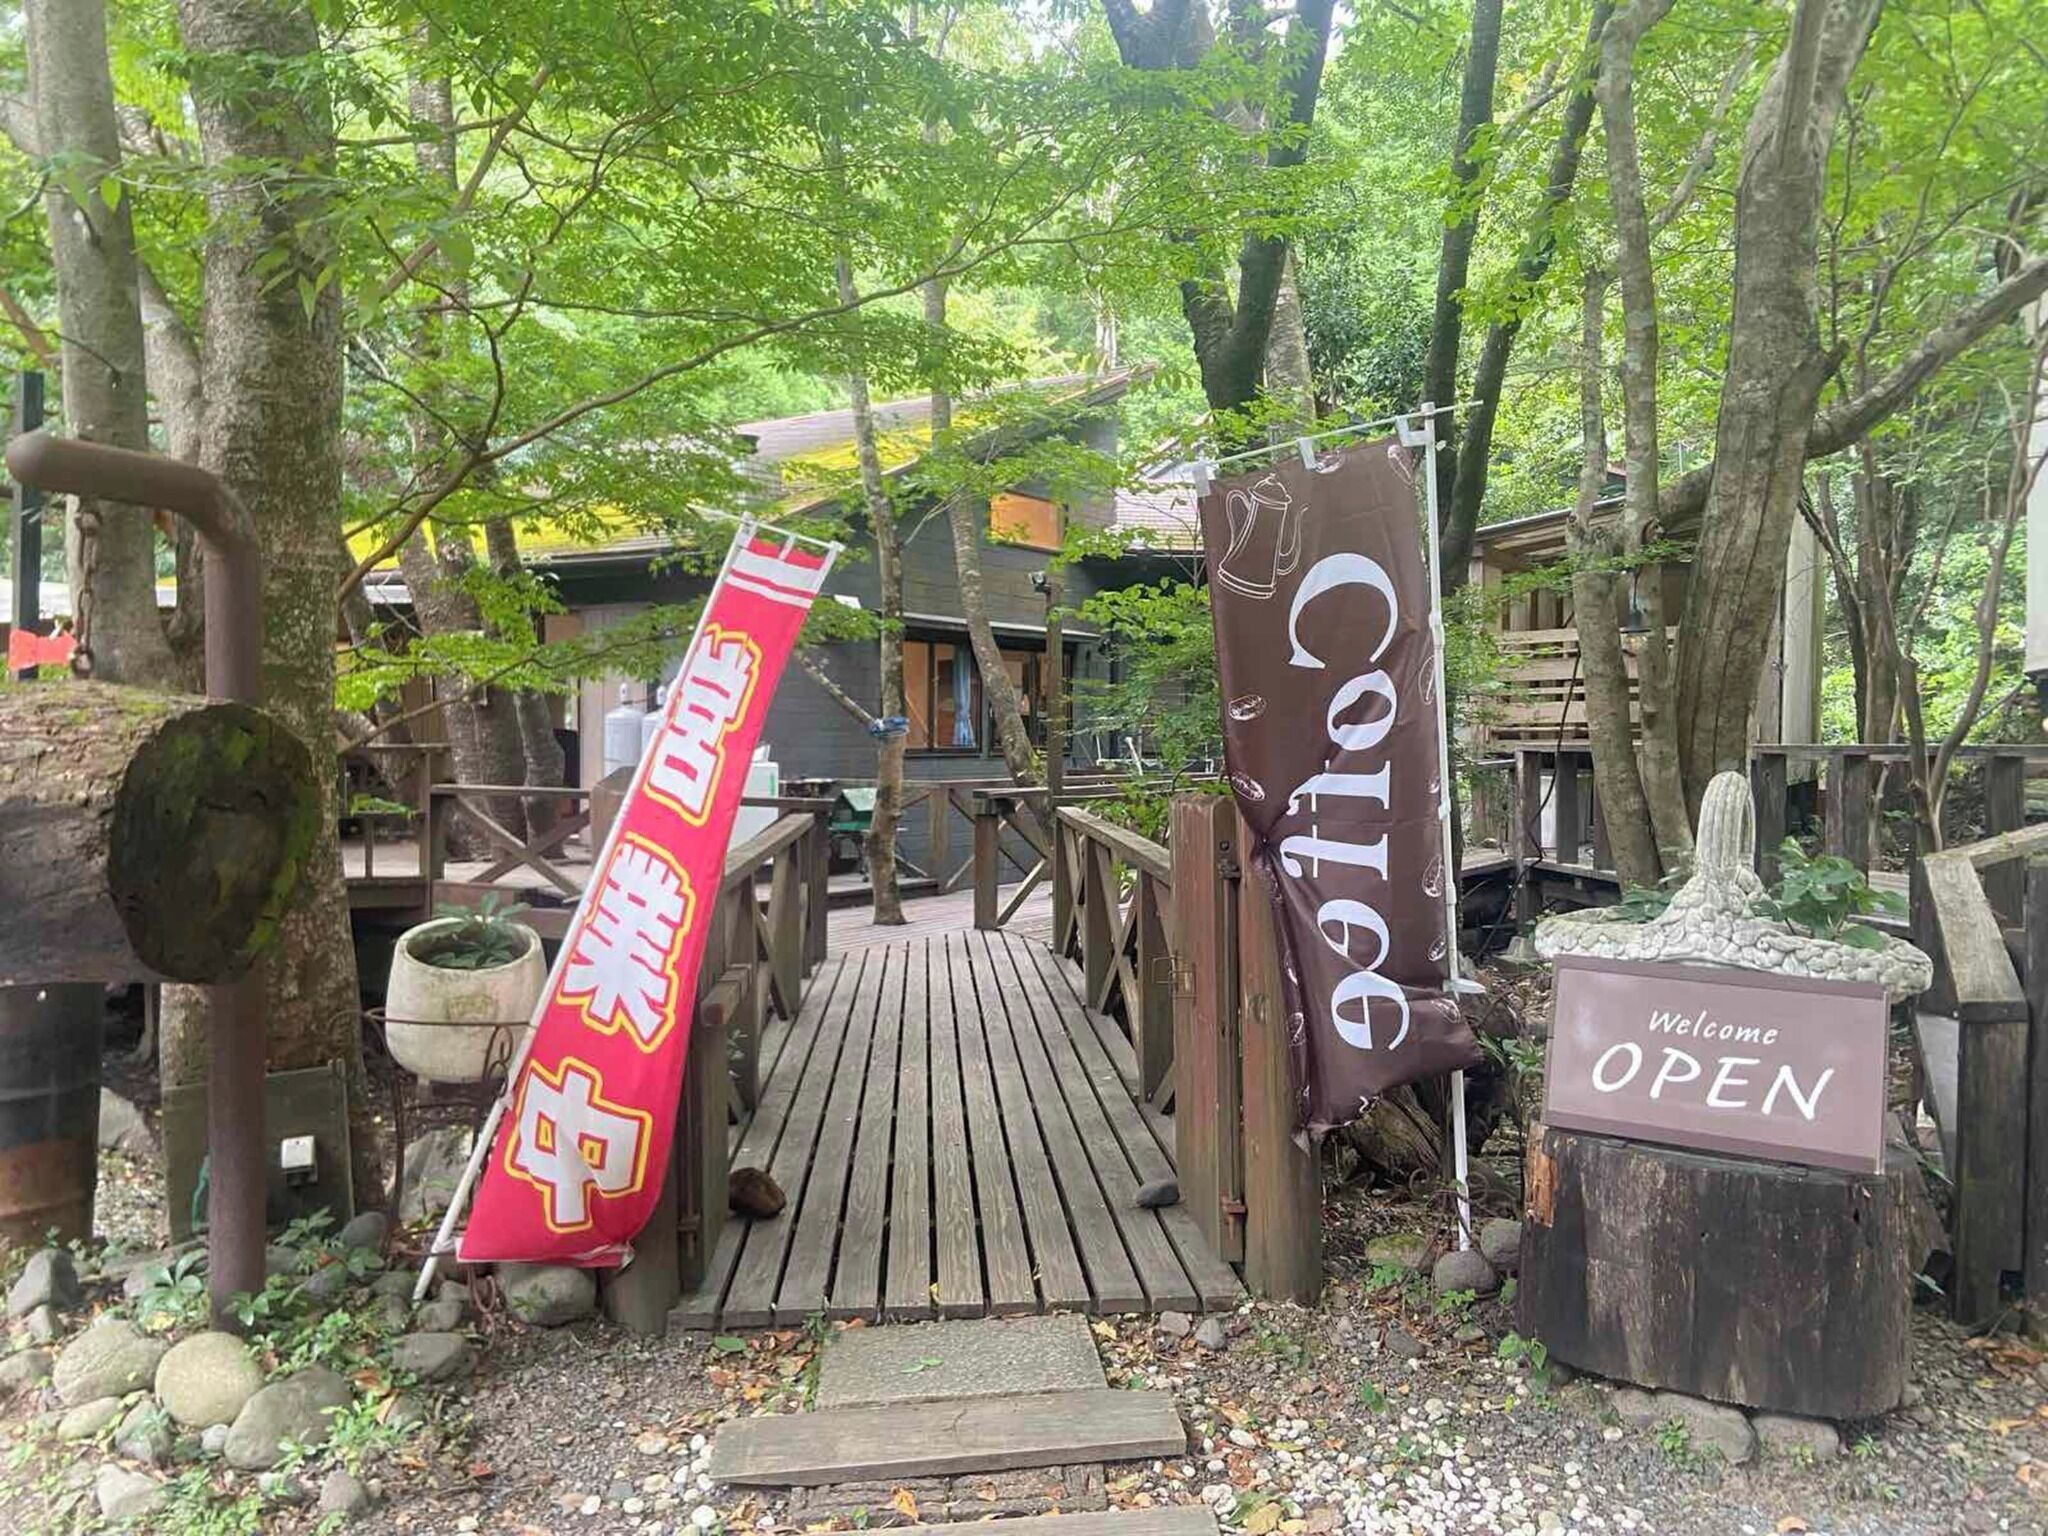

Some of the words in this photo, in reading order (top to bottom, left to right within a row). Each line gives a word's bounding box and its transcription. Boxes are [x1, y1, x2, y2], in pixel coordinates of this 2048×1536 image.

[506, 624, 760, 1231] 営業中
[1648, 1009, 1781, 1046] Welcome
[1591, 1041, 1835, 1122] OPEN
